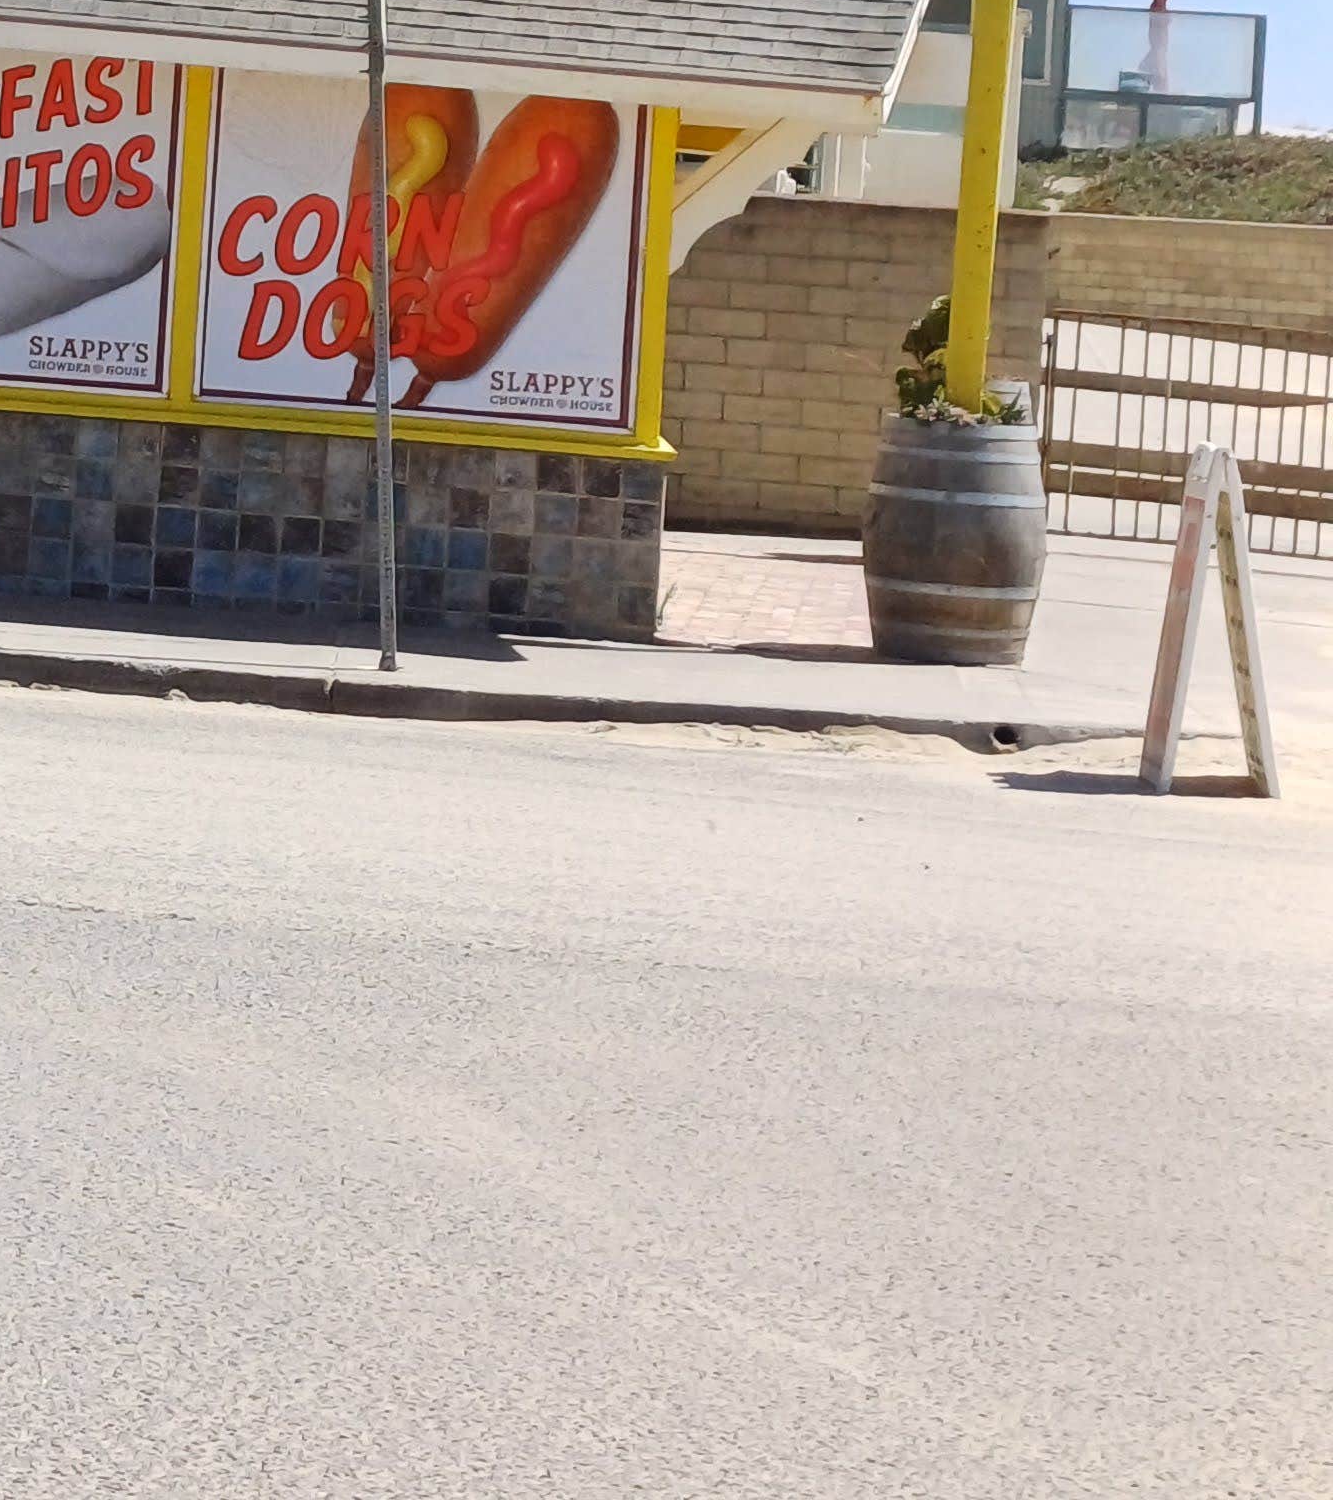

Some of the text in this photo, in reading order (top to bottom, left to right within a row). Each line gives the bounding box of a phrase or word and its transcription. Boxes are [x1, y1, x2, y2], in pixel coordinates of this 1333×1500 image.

[217, 192, 466, 277] CORN
[237, 275, 491, 360] DOGS
[29, 335, 149, 364] SLAPPY'S
[28, 360, 148, 377] CHOWDER HOUSE
[490, 370, 614, 398] SLAPPY'S
[489, 395, 613, 412] CHOWDER HOUSE
